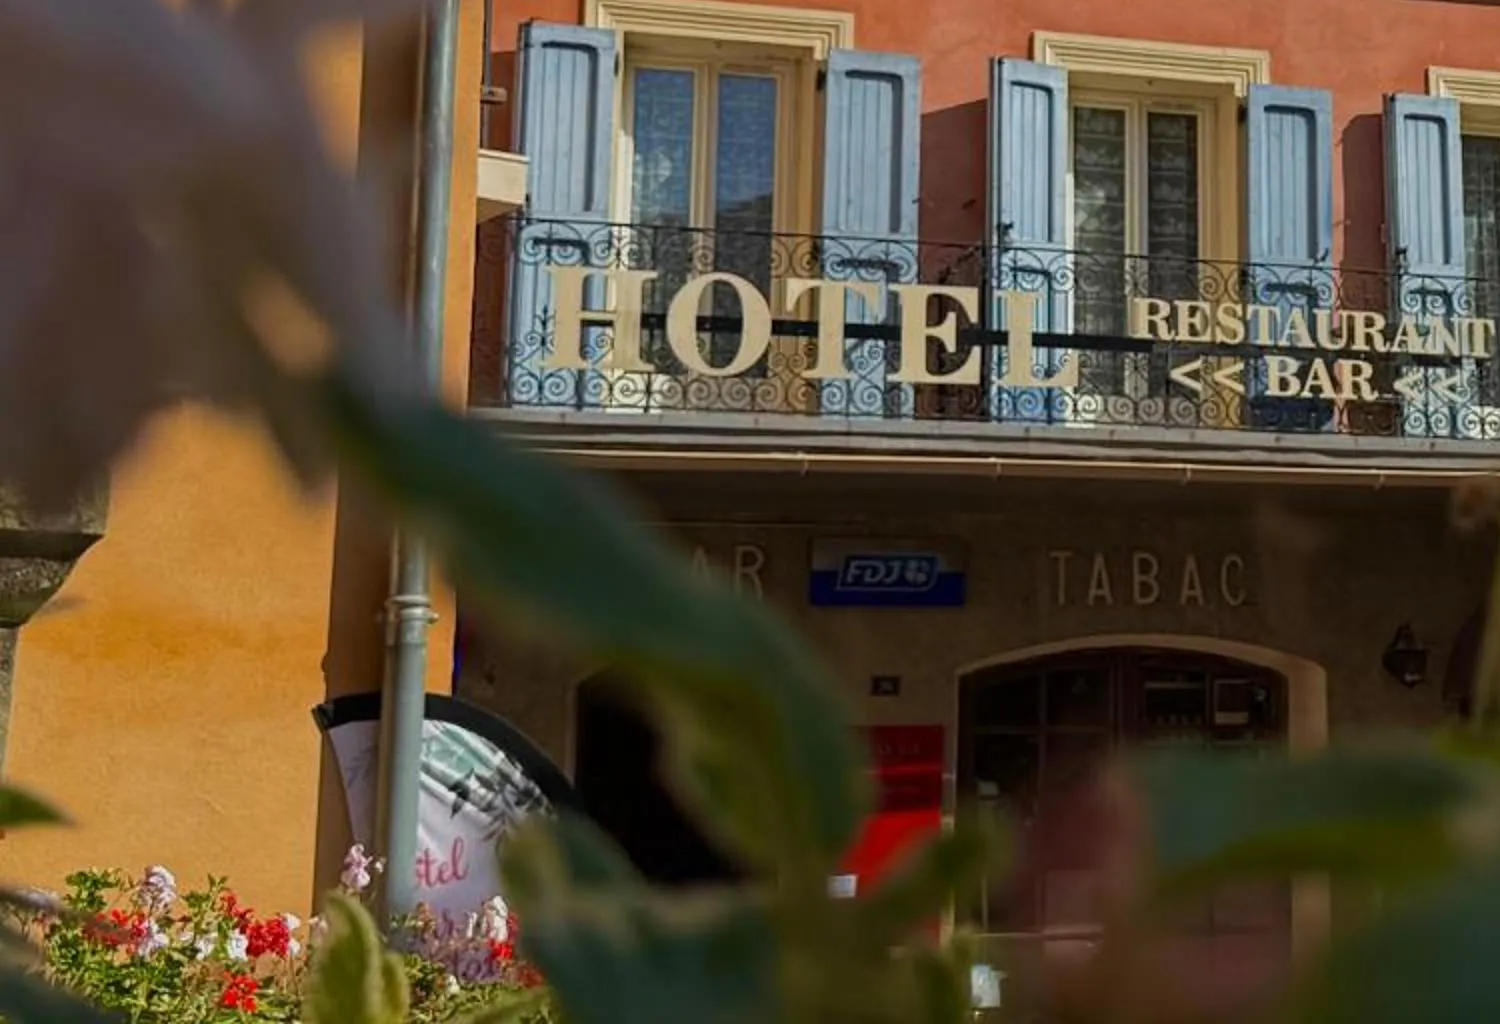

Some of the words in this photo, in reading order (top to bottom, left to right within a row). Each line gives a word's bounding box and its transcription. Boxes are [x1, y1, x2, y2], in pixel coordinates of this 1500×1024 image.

[545, 264, 1080, 387] HOTEL
[1131, 297, 1496, 360] RESTAURANT
[1264, 355, 1379, 402] BAR
[692, 543, 766, 601] AR
[845, 559, 904, 585] FDJ
[1048, 550, 1248, 607] TABAC
[415, 837, 469, 886] tel
